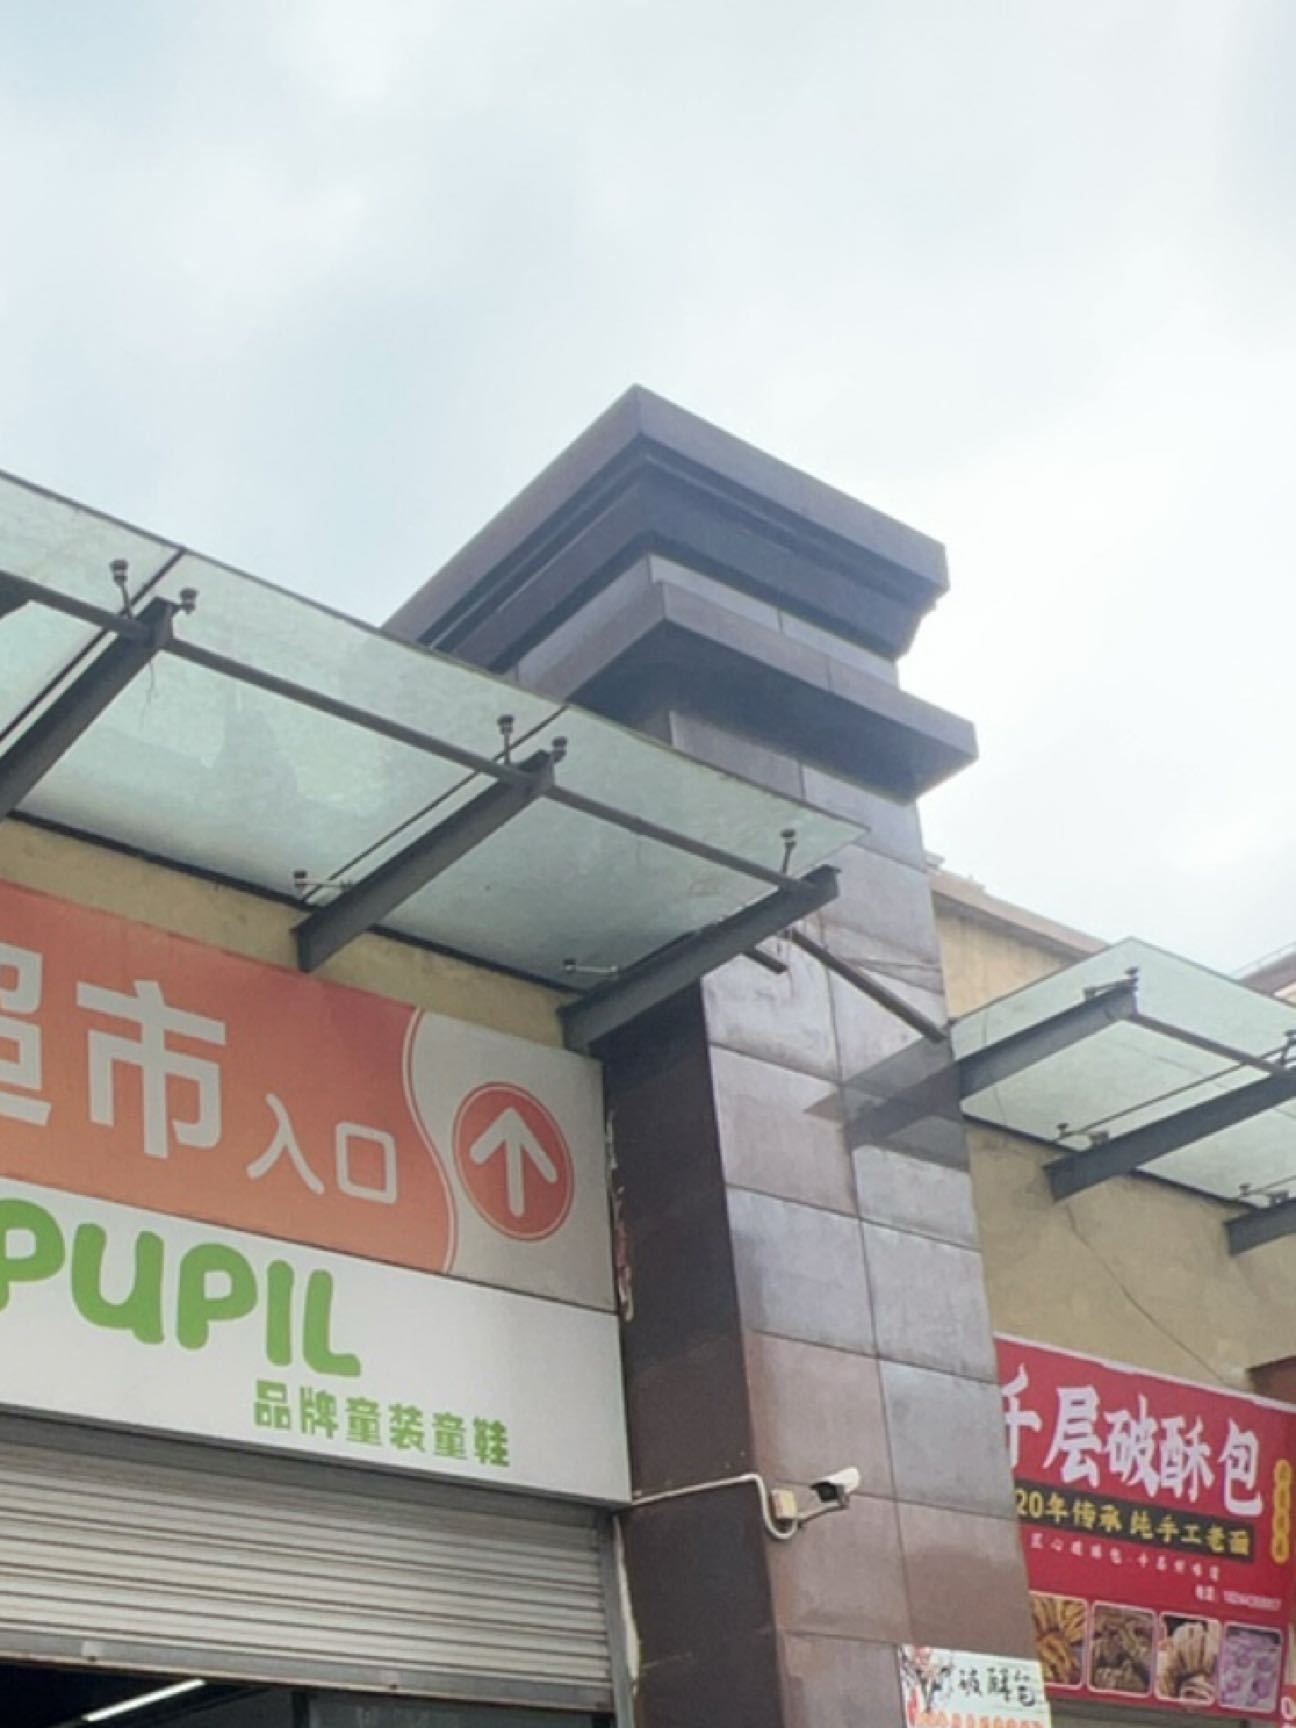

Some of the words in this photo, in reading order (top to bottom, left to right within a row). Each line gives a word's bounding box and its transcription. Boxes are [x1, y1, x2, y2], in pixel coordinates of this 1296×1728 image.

[246, 1093, 398, 1204] 入口
[255, 1379, 510, 1467] 品牌童装童鞋
